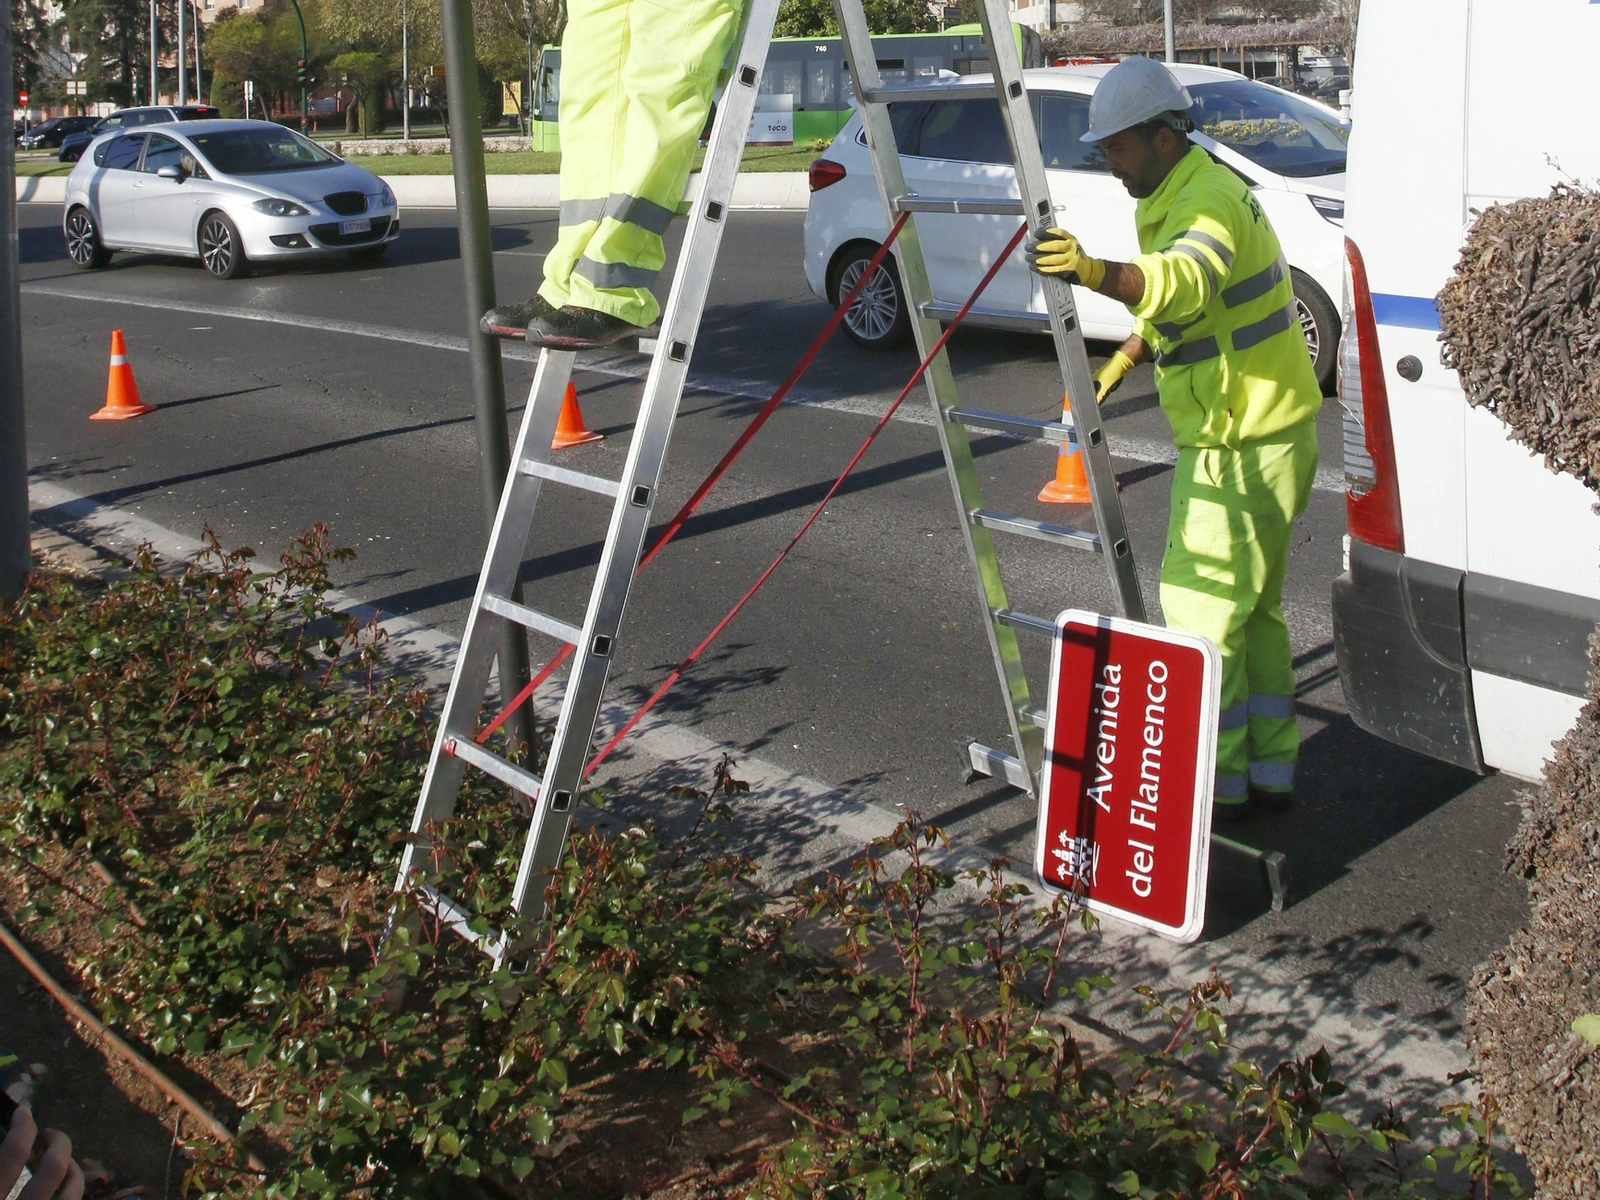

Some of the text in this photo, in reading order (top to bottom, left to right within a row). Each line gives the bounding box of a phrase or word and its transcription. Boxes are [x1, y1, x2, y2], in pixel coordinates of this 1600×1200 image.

[1086, 663, 1122, 814] Avenida
[1125, 660, 1169, 898] del Flamenco
